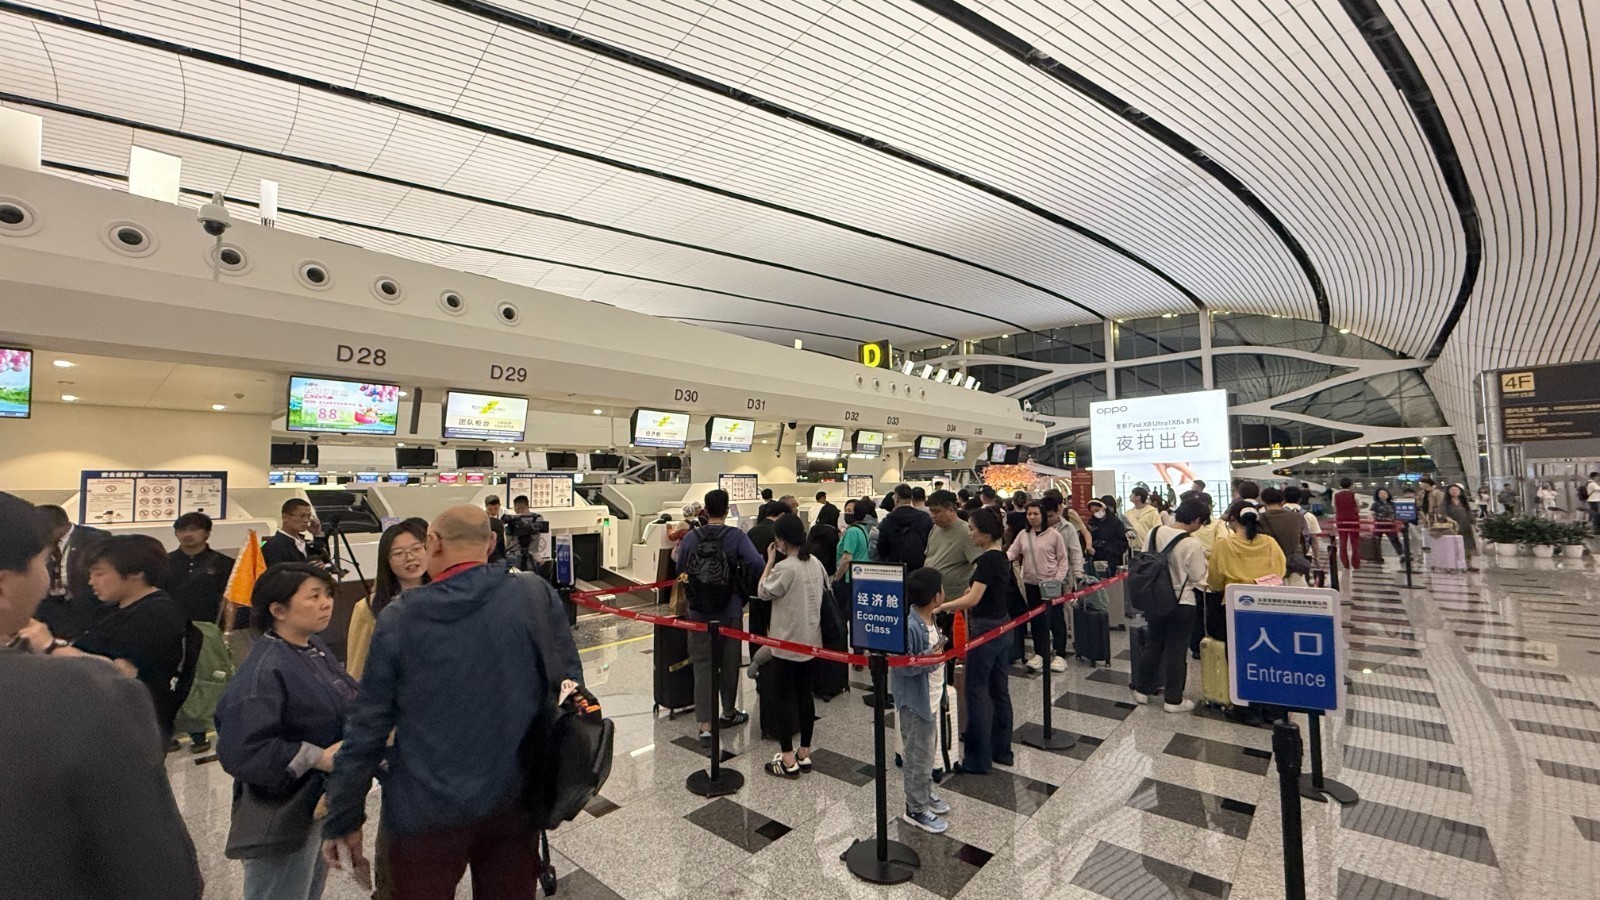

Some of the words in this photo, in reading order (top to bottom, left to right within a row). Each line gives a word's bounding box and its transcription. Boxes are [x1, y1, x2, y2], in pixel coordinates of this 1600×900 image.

[337, 344, 387, 366] D28
[863, 344, 881, 368] D
[490, 364, 527, 382] D29
[1504, 375, 1532, 389] 4F
[674, 389, 699, 403] D30
[746, 398, 766, 411] D31
[318, 408, 337, 419] 88
[844, 411, 860, 421] D32
[458, 418, 490, 428] 团队柜台
[886, 416, 900, 426] D33
[946, 423, 957, 432] D34
[1116, 430, 1200, 452] 夜拍出色
[857, 592, 899, 609] 经济舱
[856, 610, 899, 626] Economy
[864, 623, 891, 635] Class
[1248, 626, 1323, 656] 入口
[1246, 662, 1326, 688] Entrance
